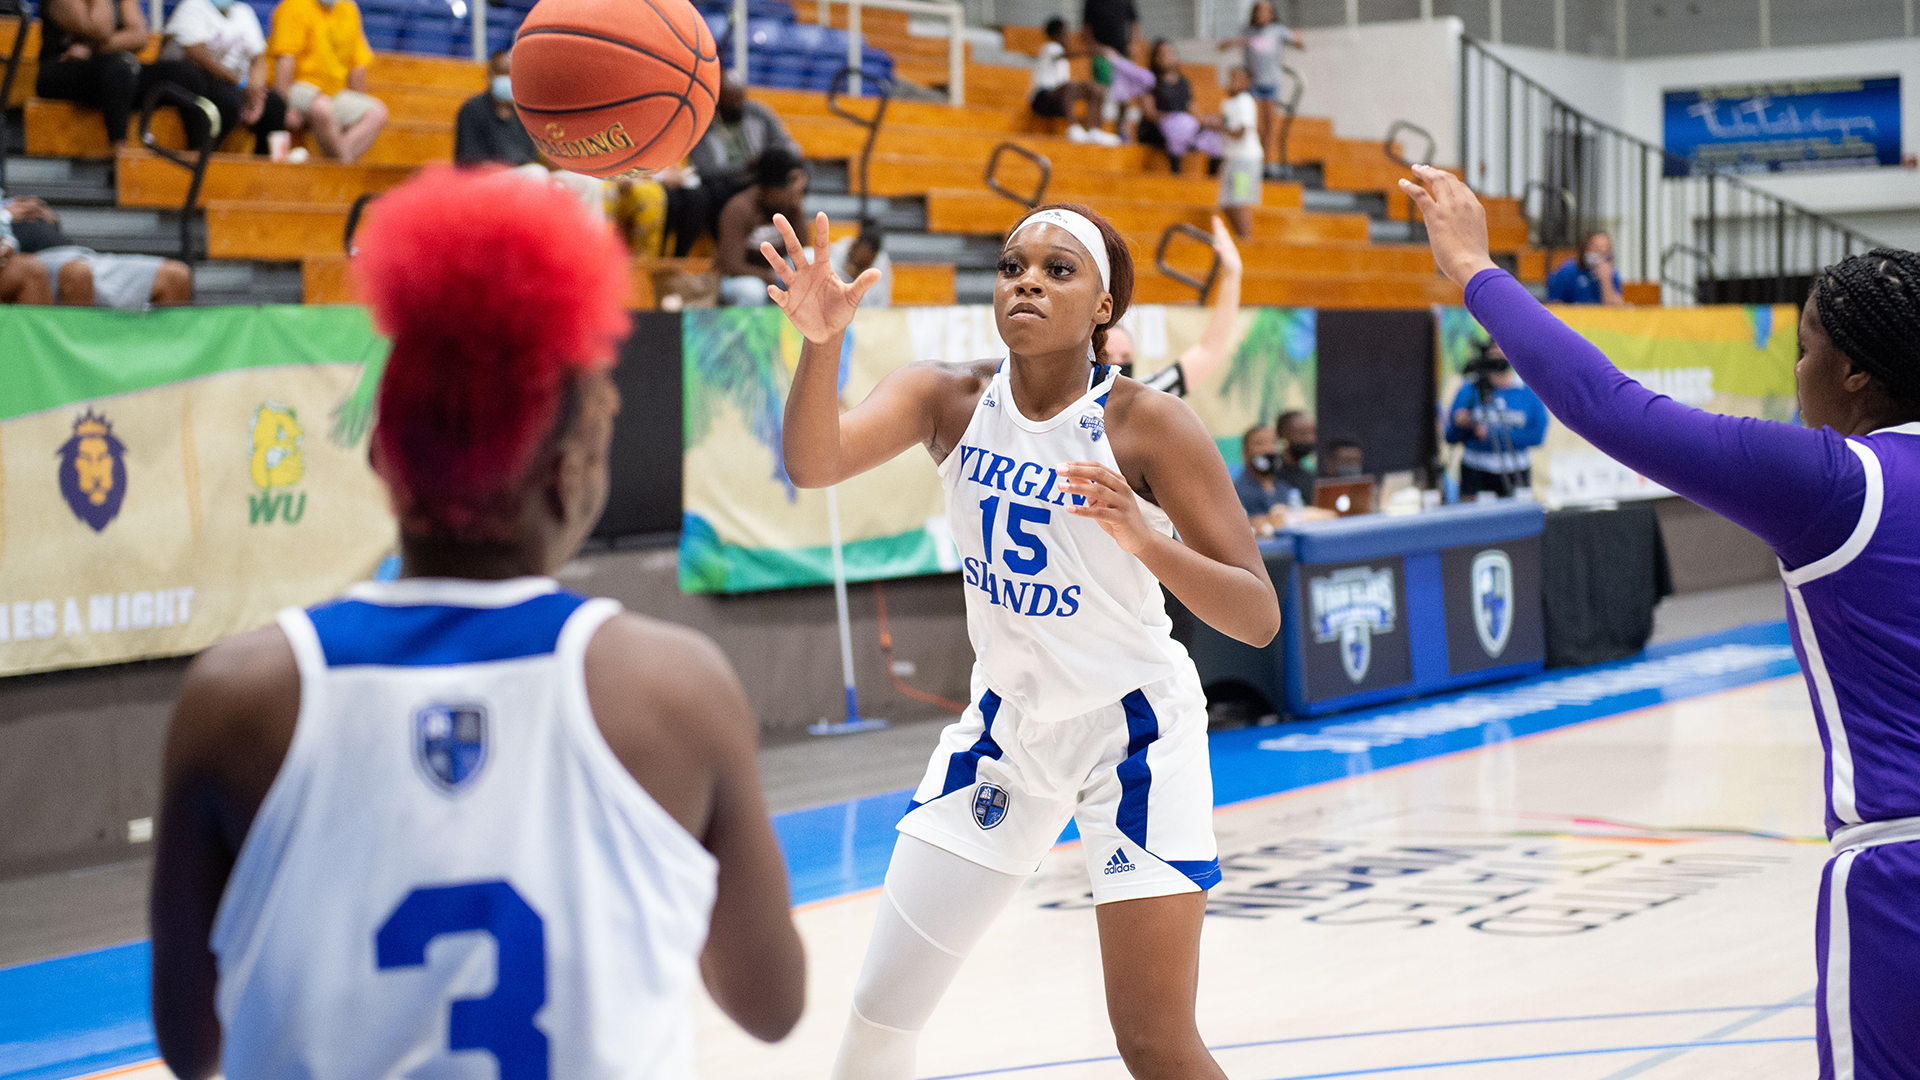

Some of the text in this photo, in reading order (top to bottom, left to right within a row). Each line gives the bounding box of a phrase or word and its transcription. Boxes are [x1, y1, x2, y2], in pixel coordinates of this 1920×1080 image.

[248, 492, 306, 525] WU
[979, 495, 1052, 576] 15
[63, 596, 83, 636] A
[89, 586, 194, 634] NIGHT
[963, 556, 1082, 617] SLANDS
[1103, 863, 1136, 875] adidas
[376, 881, 548, 1080] 3
